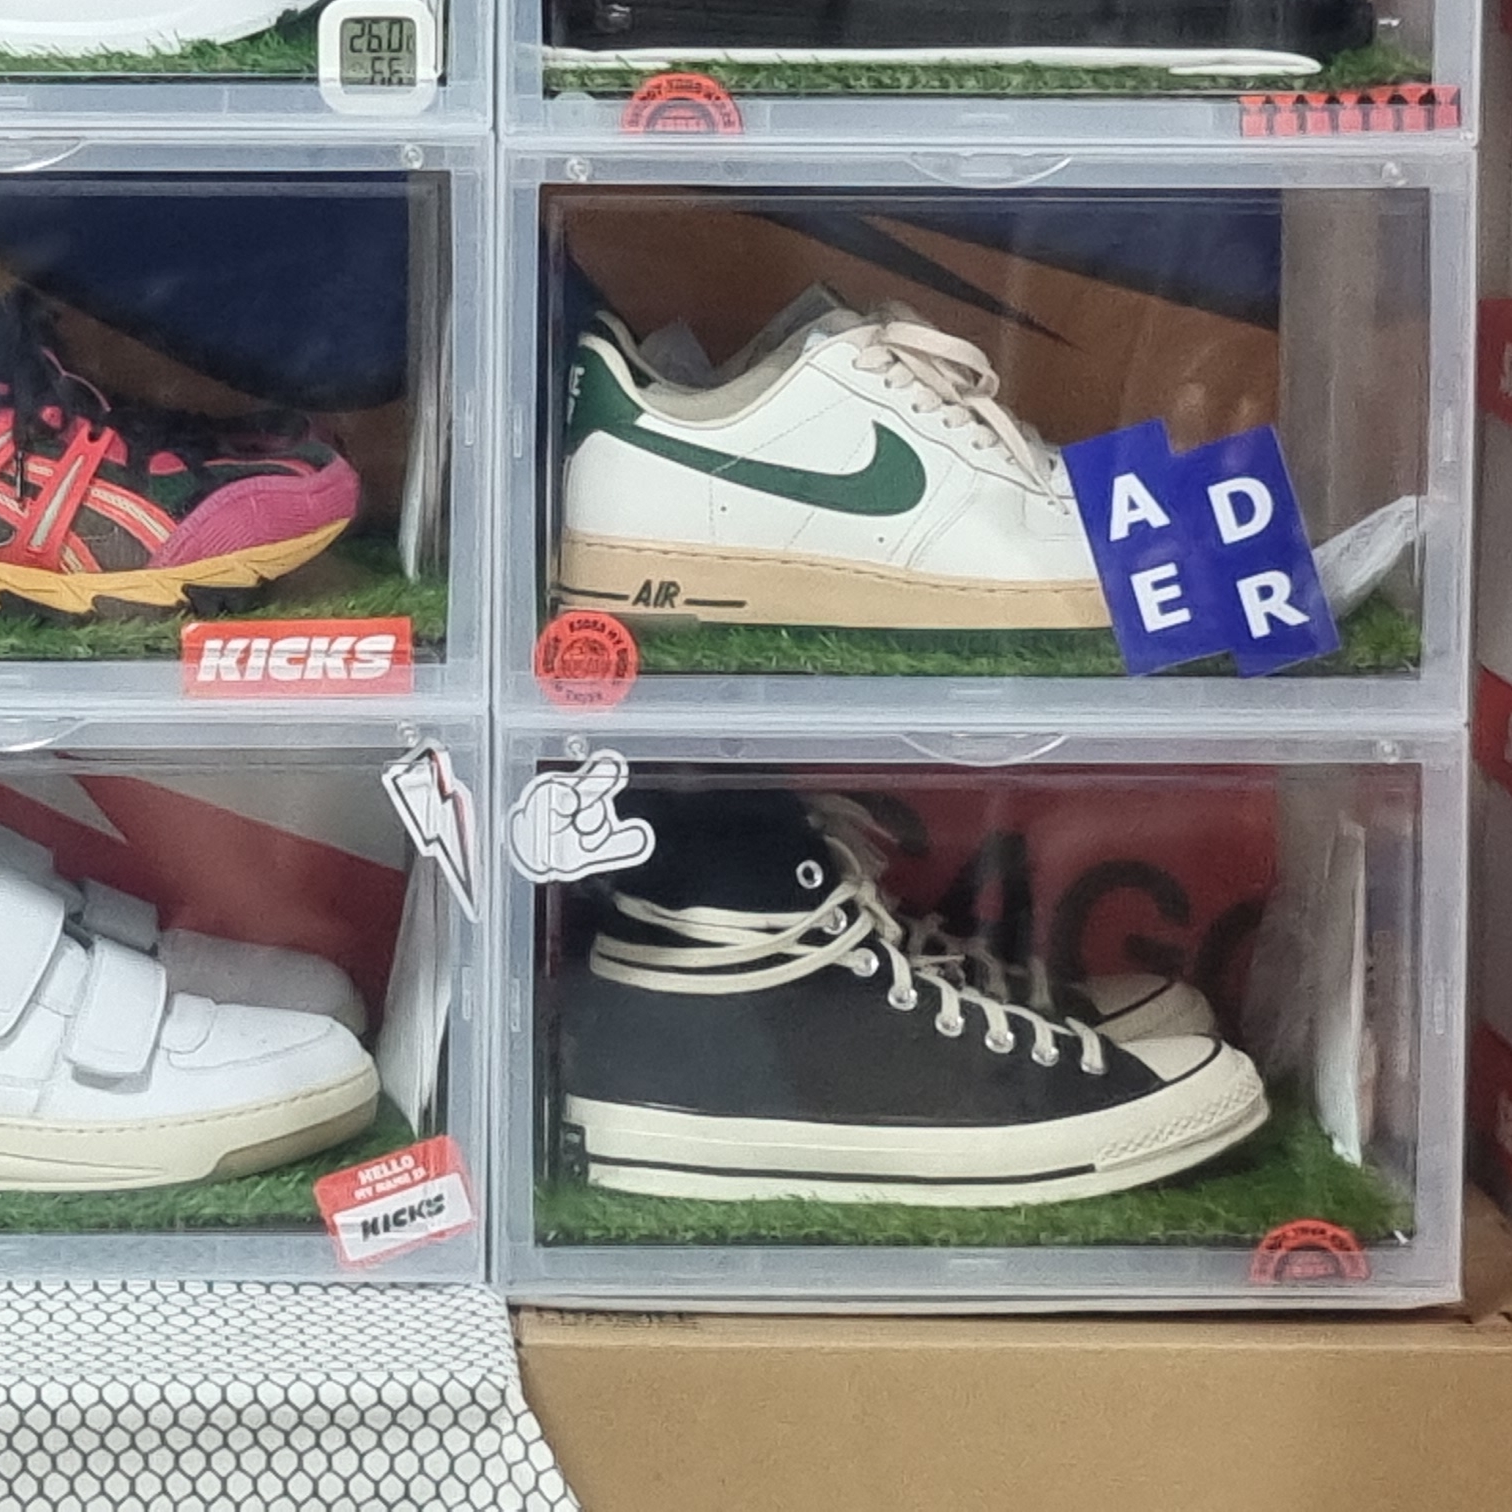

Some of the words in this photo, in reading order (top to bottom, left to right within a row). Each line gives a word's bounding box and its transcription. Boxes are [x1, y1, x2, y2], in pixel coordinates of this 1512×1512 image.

[632, 578, 681, 609] AIR
[196, 634, 397, 683] KICKS
[357, 1153, 416, 1187] HELLO
[361, 1193, 446, 1242] KICKS
